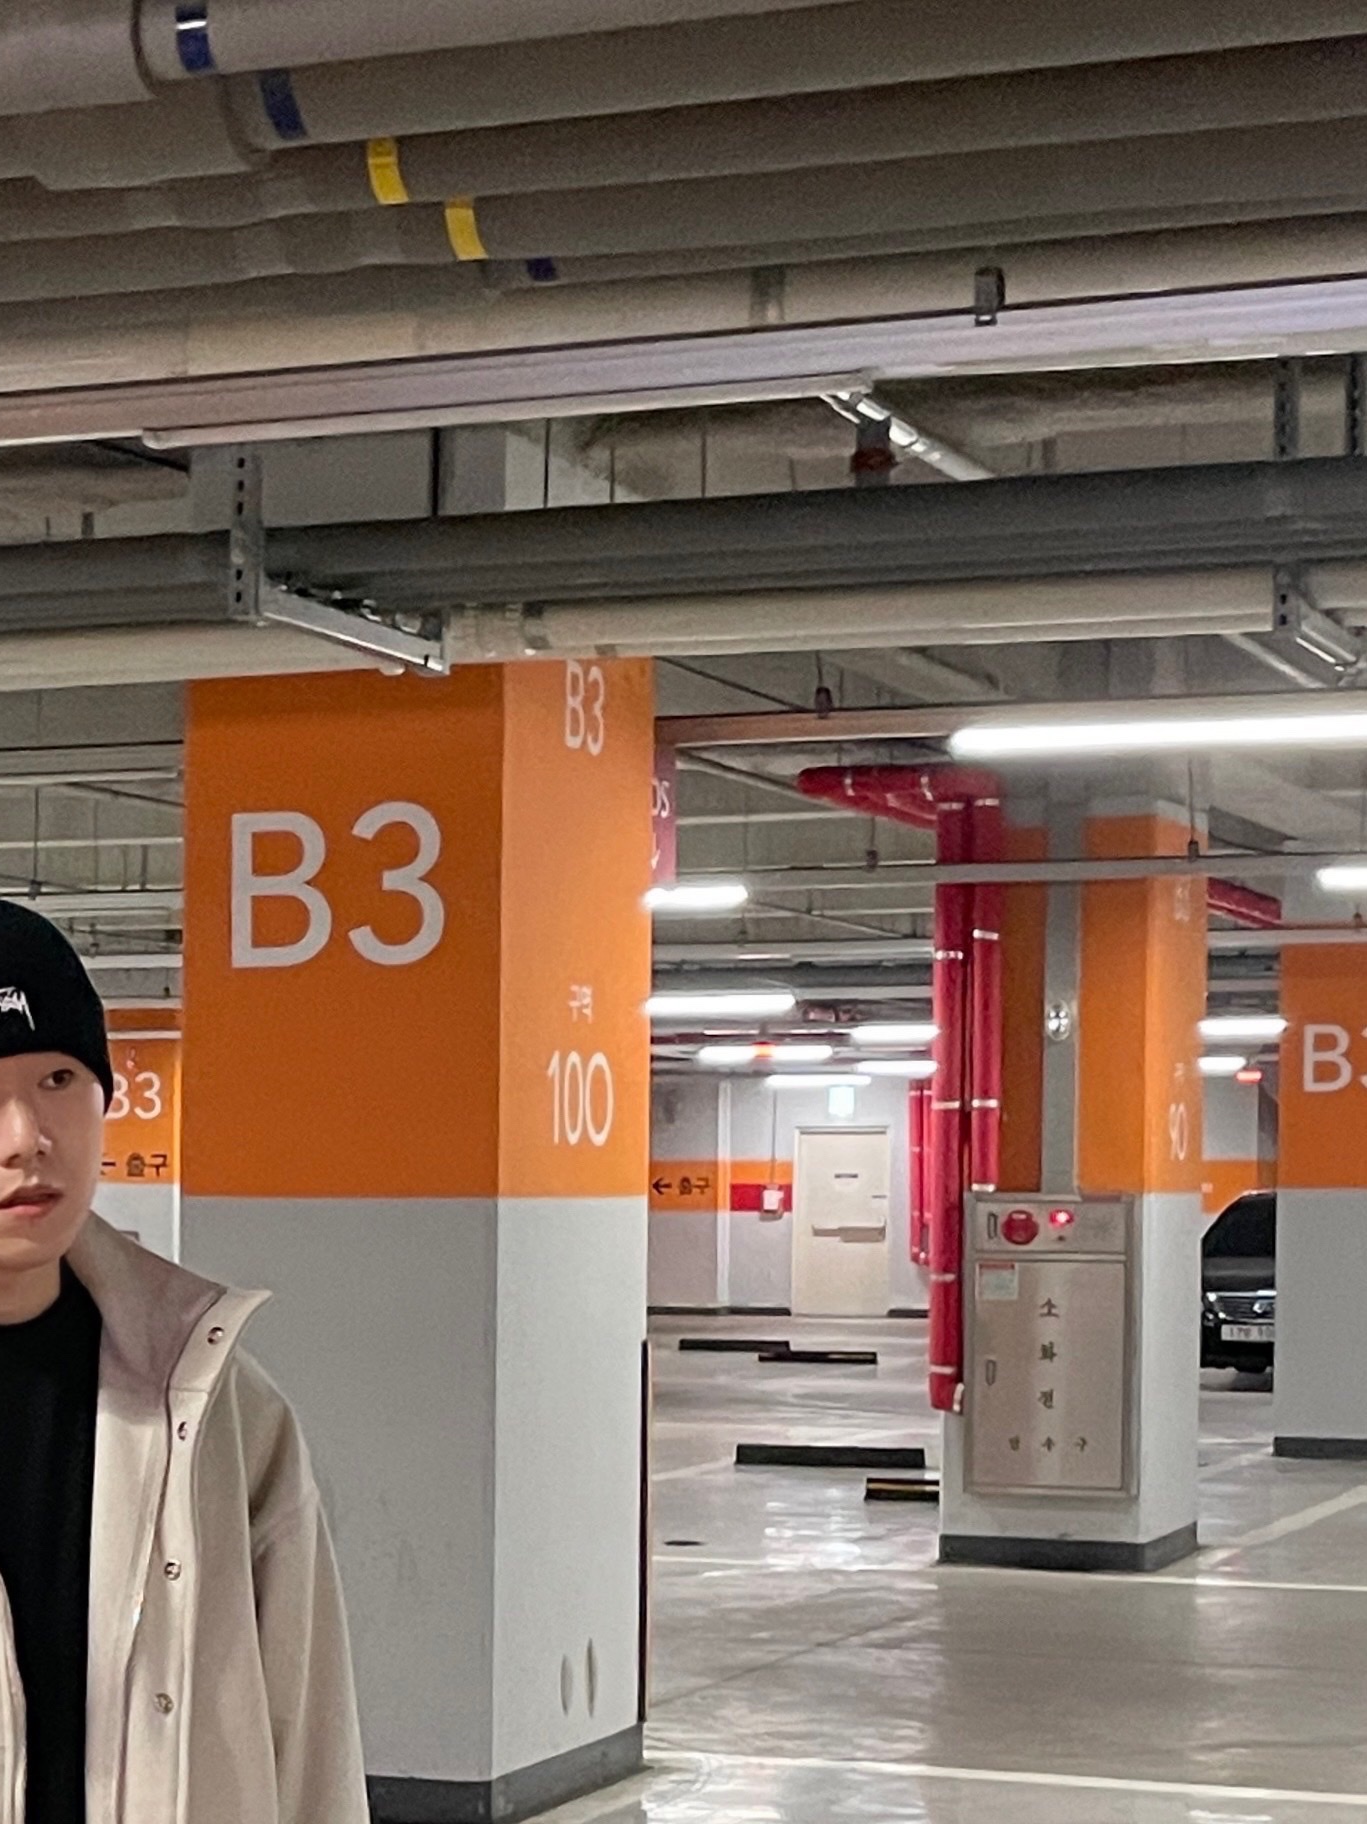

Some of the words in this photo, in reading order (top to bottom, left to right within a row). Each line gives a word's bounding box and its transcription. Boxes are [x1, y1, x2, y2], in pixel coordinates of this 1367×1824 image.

[565, 659, 605, 757] B3
[232, 801, 445, 969] B3
[1303, 1023, 1367, 1092] B
